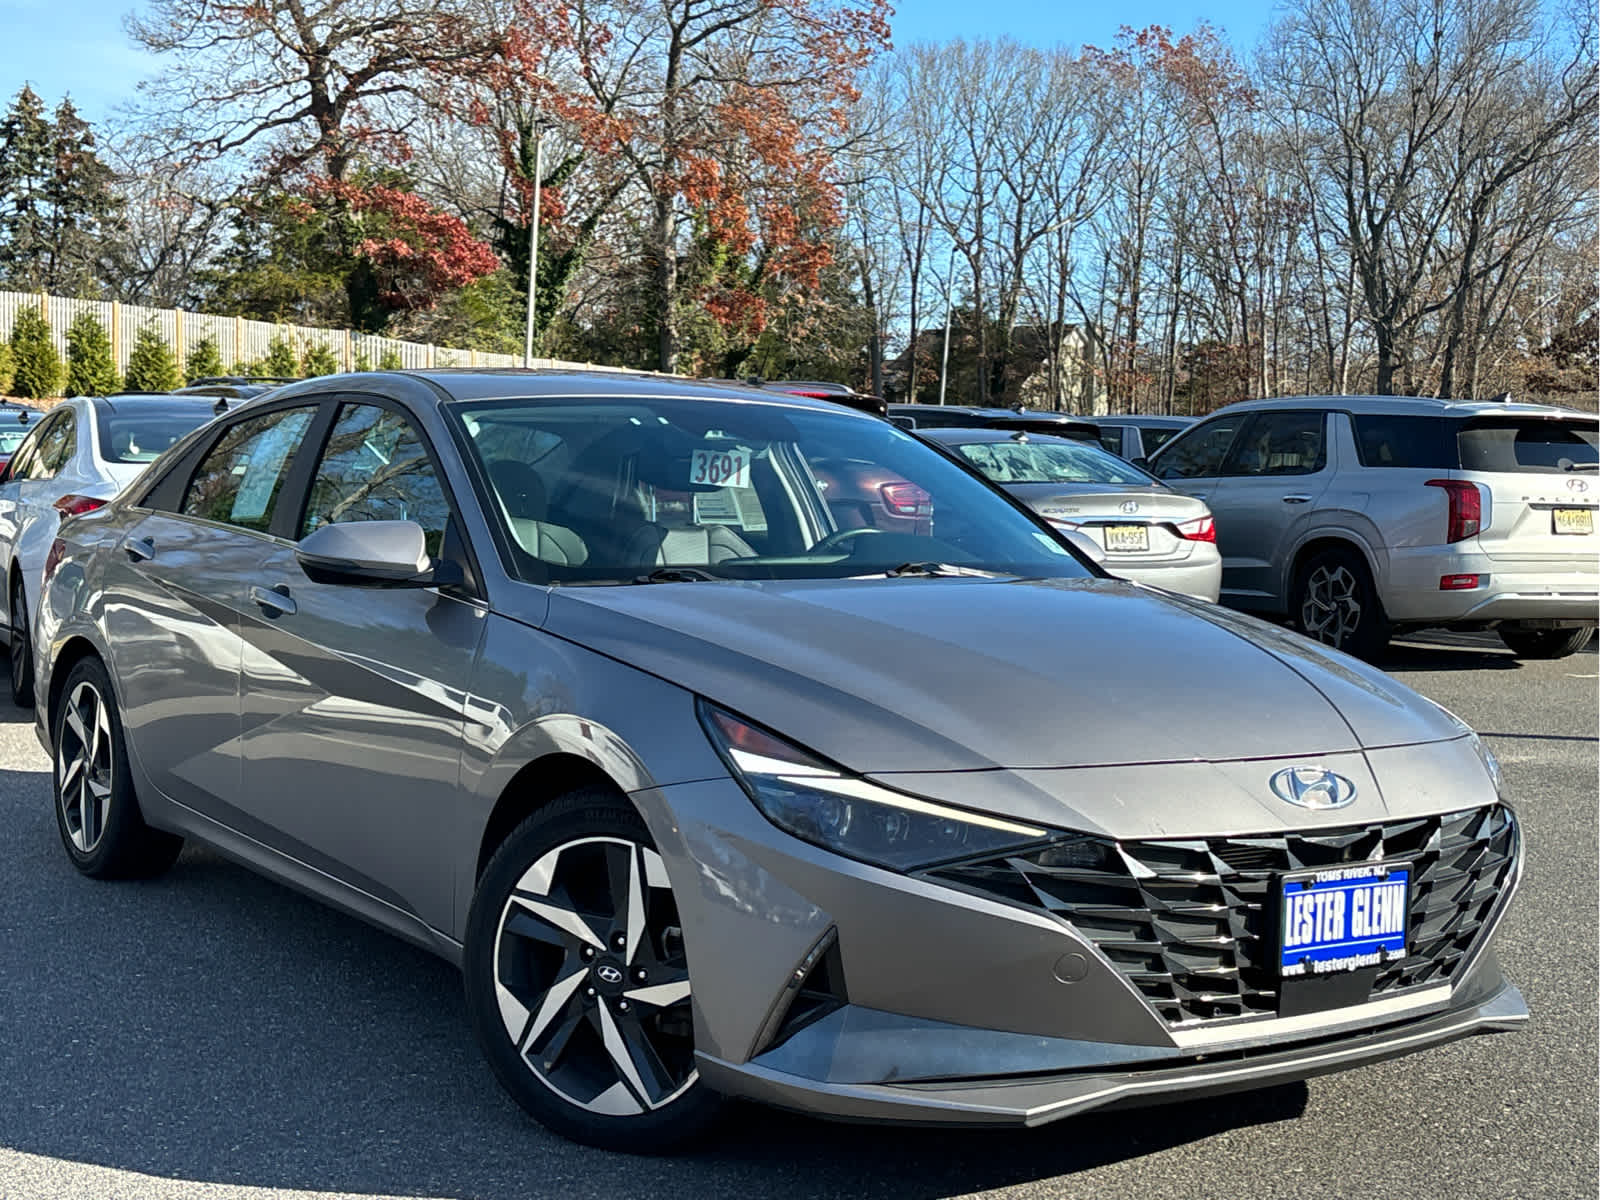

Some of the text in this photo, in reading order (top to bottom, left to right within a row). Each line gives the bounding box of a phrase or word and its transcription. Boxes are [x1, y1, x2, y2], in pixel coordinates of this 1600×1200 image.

[695, 453, 743, 486] 3691
[1285, 885, 1405, 946] LESTER GLENN
